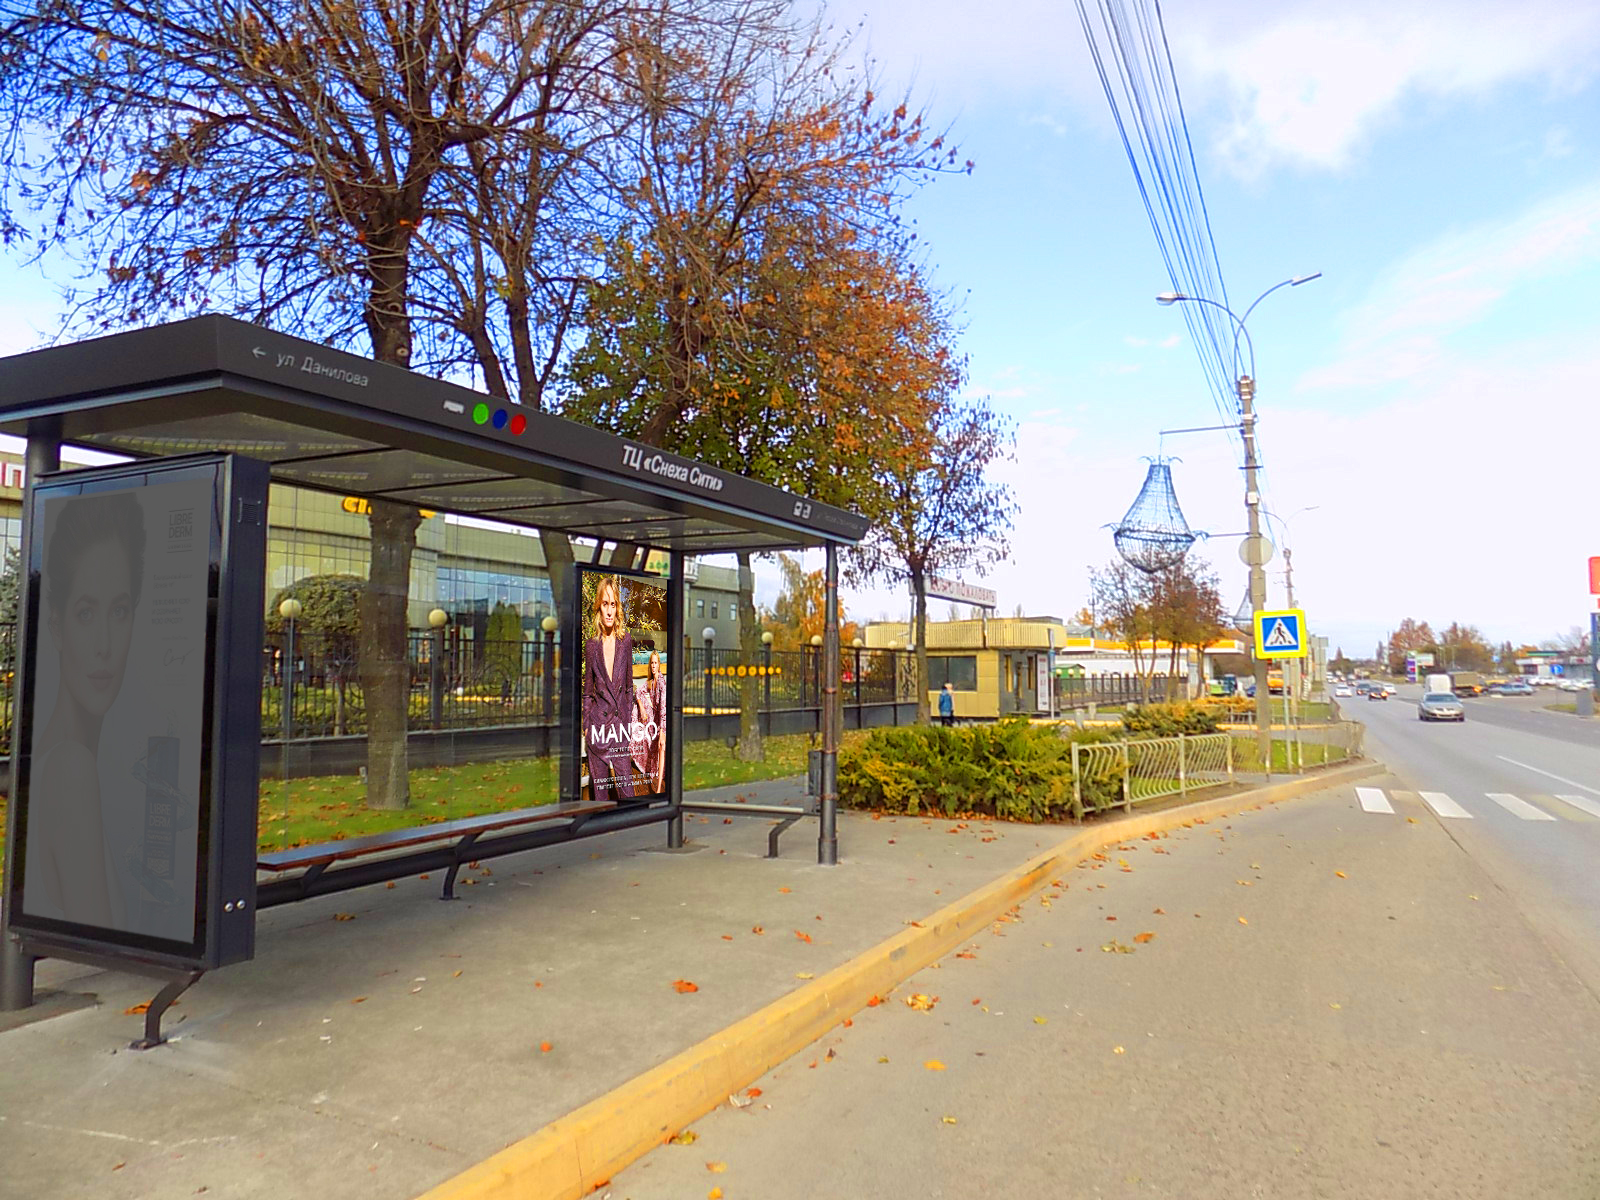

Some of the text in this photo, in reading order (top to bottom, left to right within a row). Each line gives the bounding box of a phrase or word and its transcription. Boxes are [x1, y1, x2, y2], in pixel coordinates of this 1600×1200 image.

[276, 351, 369, 387] ул Данилова
[622, 445, 642, 472] ТЦ
[169, 512, 194, 527] LIBRE
[168, 525, 193, 539] DERM
[591, 721, 658, 745] MANGO
[150, 803, 171, 815] LIBRE
